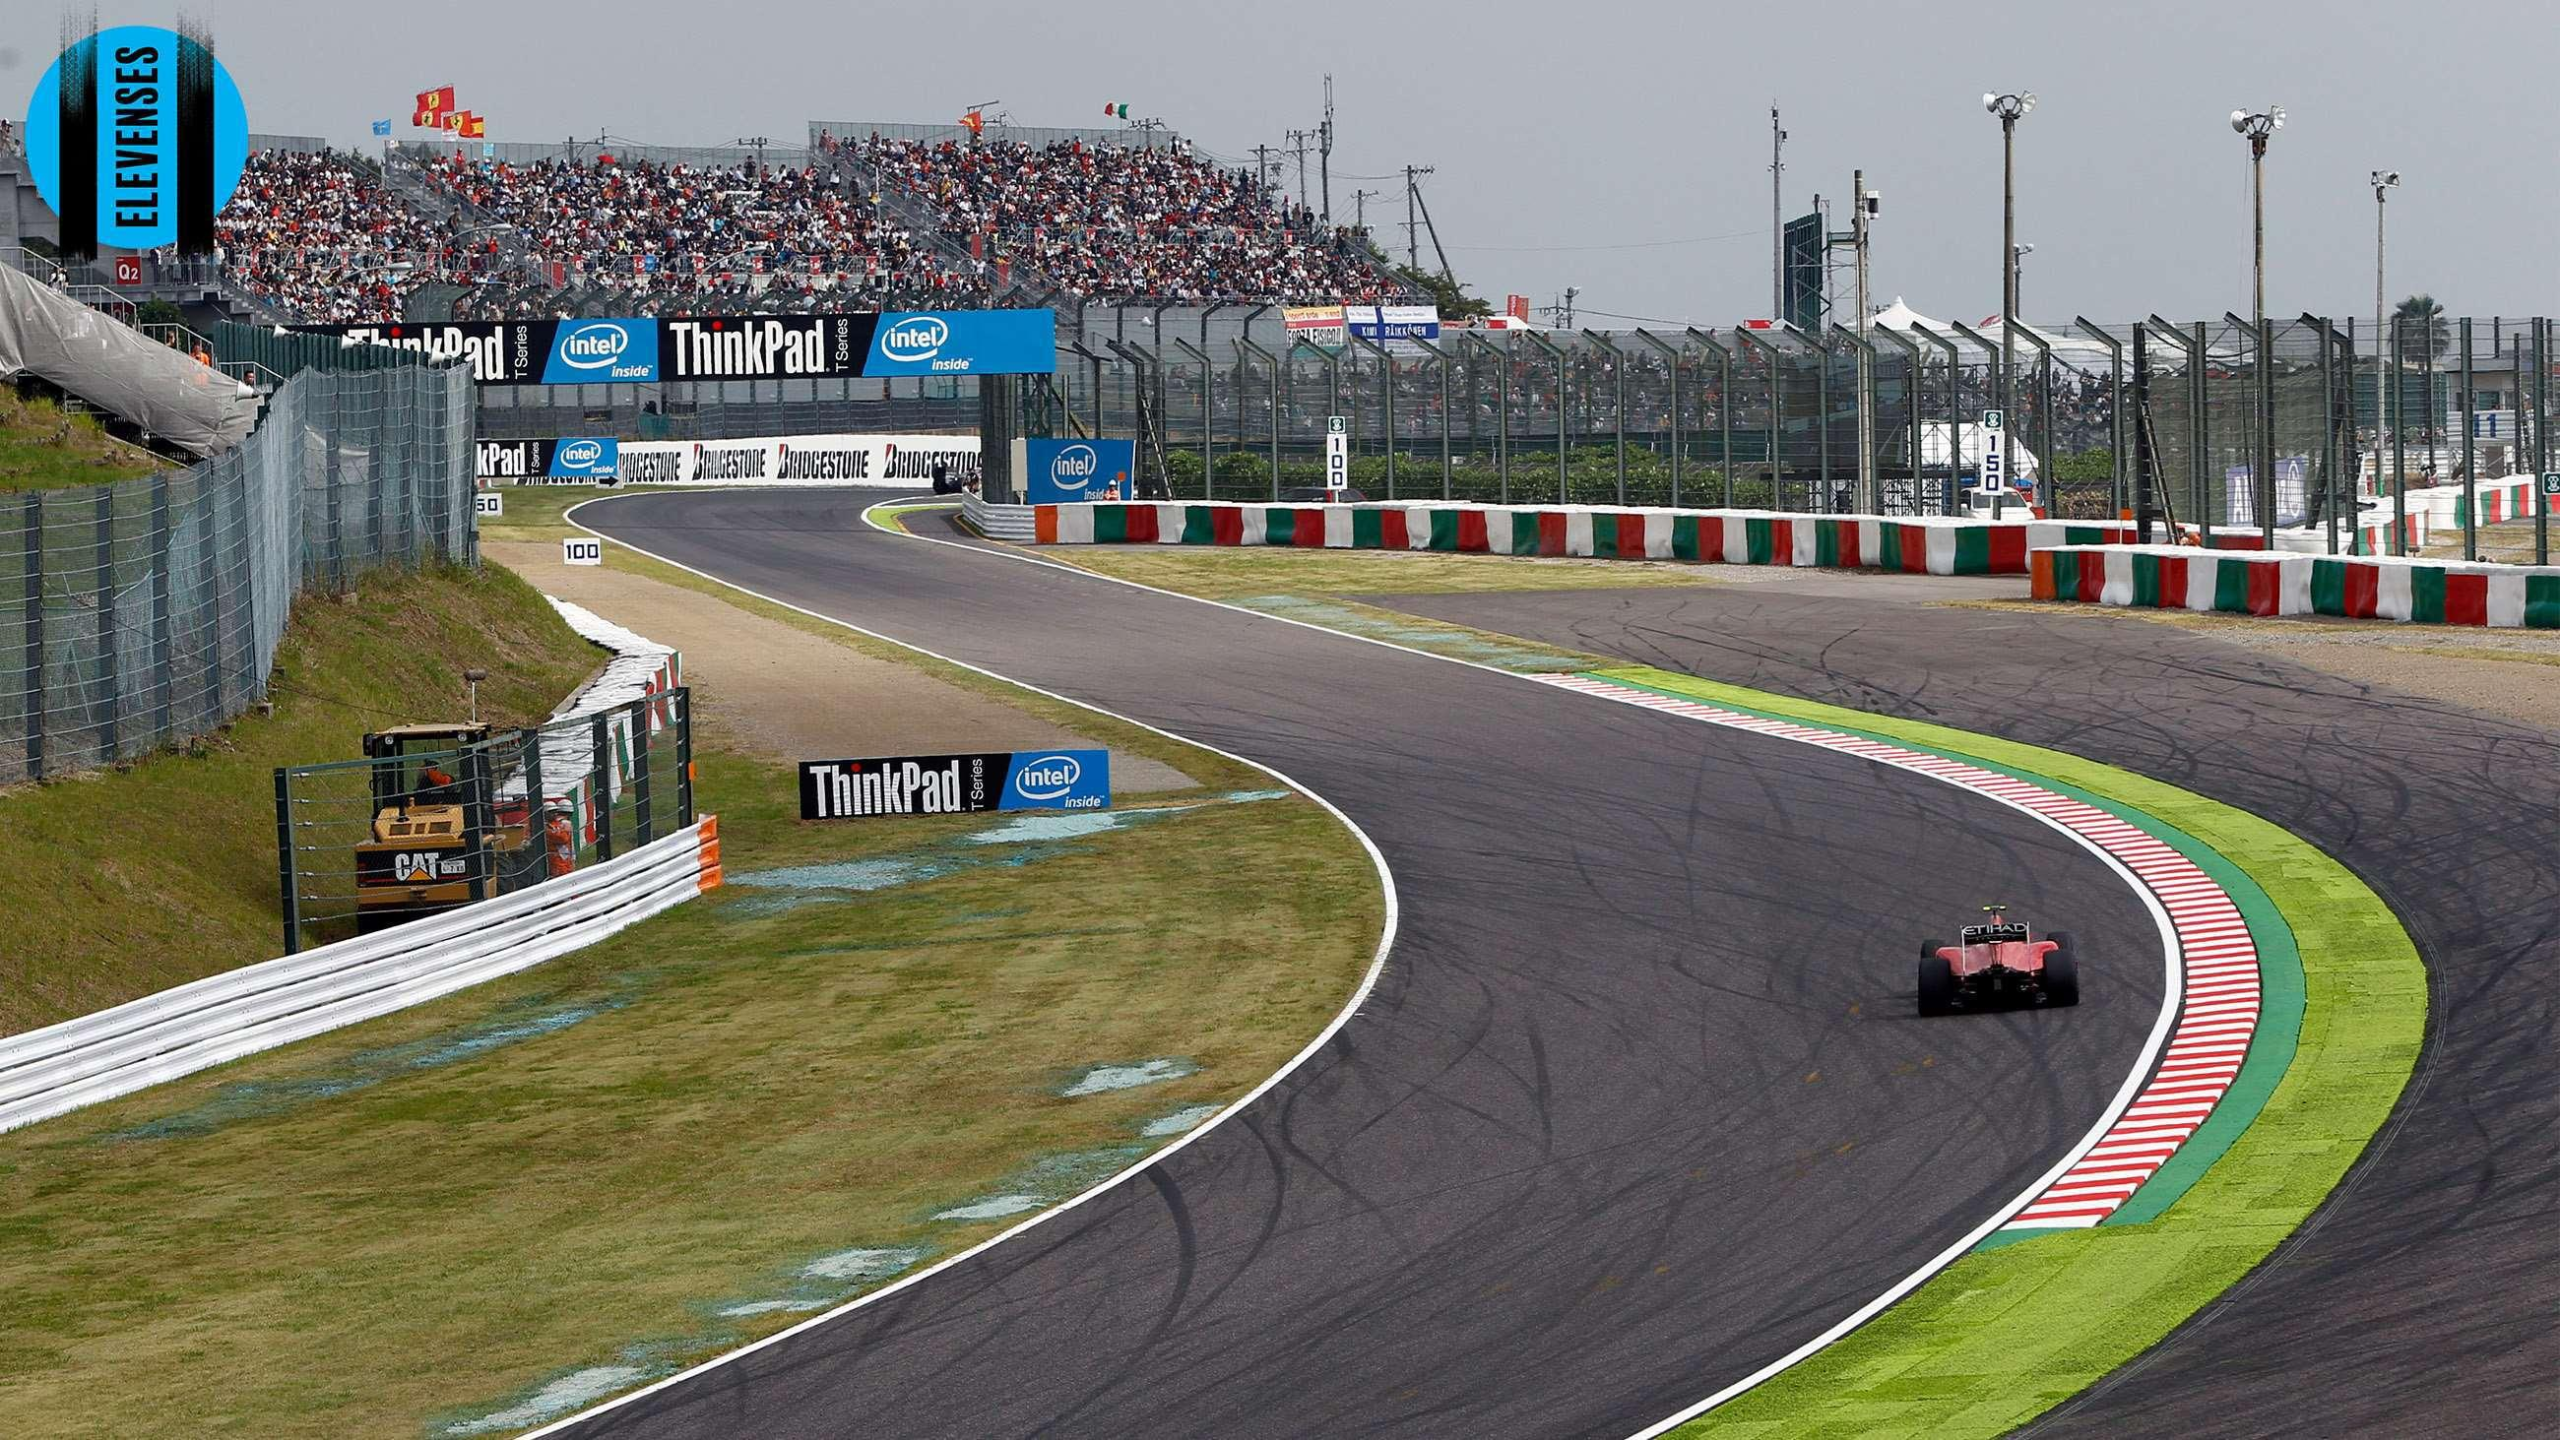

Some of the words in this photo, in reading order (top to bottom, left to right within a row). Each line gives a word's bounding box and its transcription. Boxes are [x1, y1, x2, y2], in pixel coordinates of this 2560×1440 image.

[118, 263, 139, 280] Q2
[515, 325, 528, 368] Series
[569, 331, 617, 354] intel
[835, 318, 848, 362] Series
[890, 324, 939, 348] intel
[669, 319, 825, 376] ThinkPad
[515, 369, 527, 379] T
[611, 365, 649, 378] inside
[835, 362, 848, 372] T
[932, 358, 970, 370] inside
[565, 446, 596, 460] intel
[692, 443, 766, 481] BRIDGESTONE
[777, 443, 869, 480] BRIDGESTONE
[1331, 437, 1343, 486] 100
[1985, 435, 2000, 491] 150
[591, 465, 615, 474] inside
[1057, 454, 1089, 476] intel
[1084, 488, 1105, 501] insid
[566, 543, 599, 560] 100
[971, 758, 984, 800] Series
[1024, 763, 1071, 787] intel
[809, 759, 960, 818] ThinkPad
[971, 801, 984, 811] T
[1065, 796, 1101, 808] inside
[395, 852, 439, 881] CAT
[1962, 923, 2026, 935] ETIHAD
